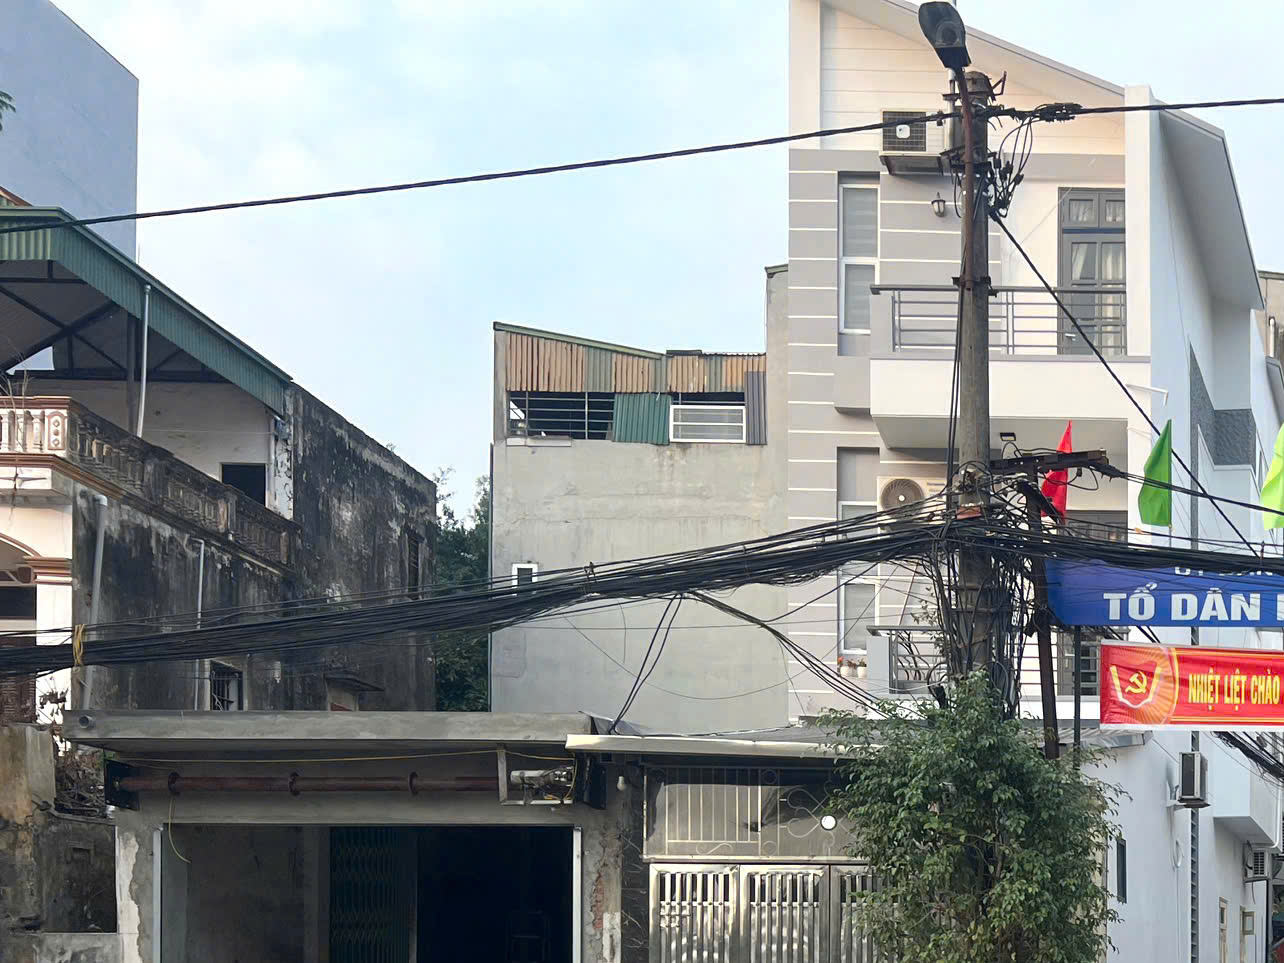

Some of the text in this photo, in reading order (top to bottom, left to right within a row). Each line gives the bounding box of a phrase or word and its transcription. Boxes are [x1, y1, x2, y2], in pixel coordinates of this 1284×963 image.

[1171, 587, 1261, 621] DÂN
[1188, 667, 1221, 711] NHIỆT
[1223, 668, 1248, 711] LIỆT
[1250, 668, 1281, 705] CHÀO
